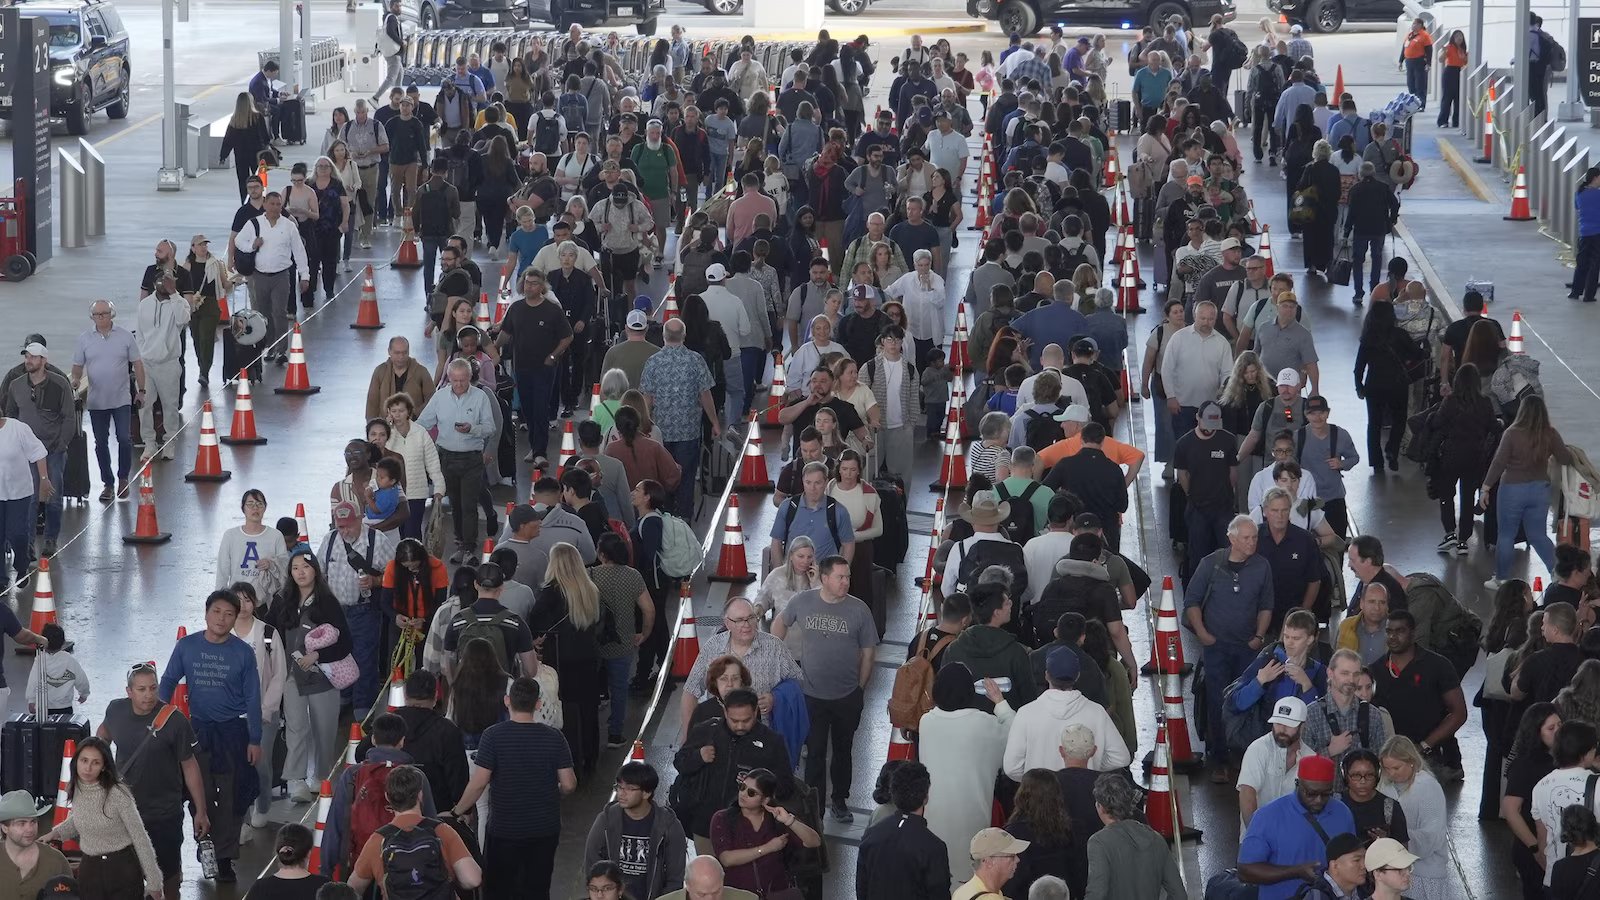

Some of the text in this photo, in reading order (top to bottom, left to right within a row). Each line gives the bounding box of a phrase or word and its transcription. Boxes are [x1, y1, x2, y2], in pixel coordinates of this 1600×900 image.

[35, 42, 48, 73] 23
[240, 541, 259, 569] A
[805, 616, 848, 634] MESA
[200, 652, 225, 662] There is
[201, 662, 230, 672] intelligent
[194, 678, 211, 686] down
